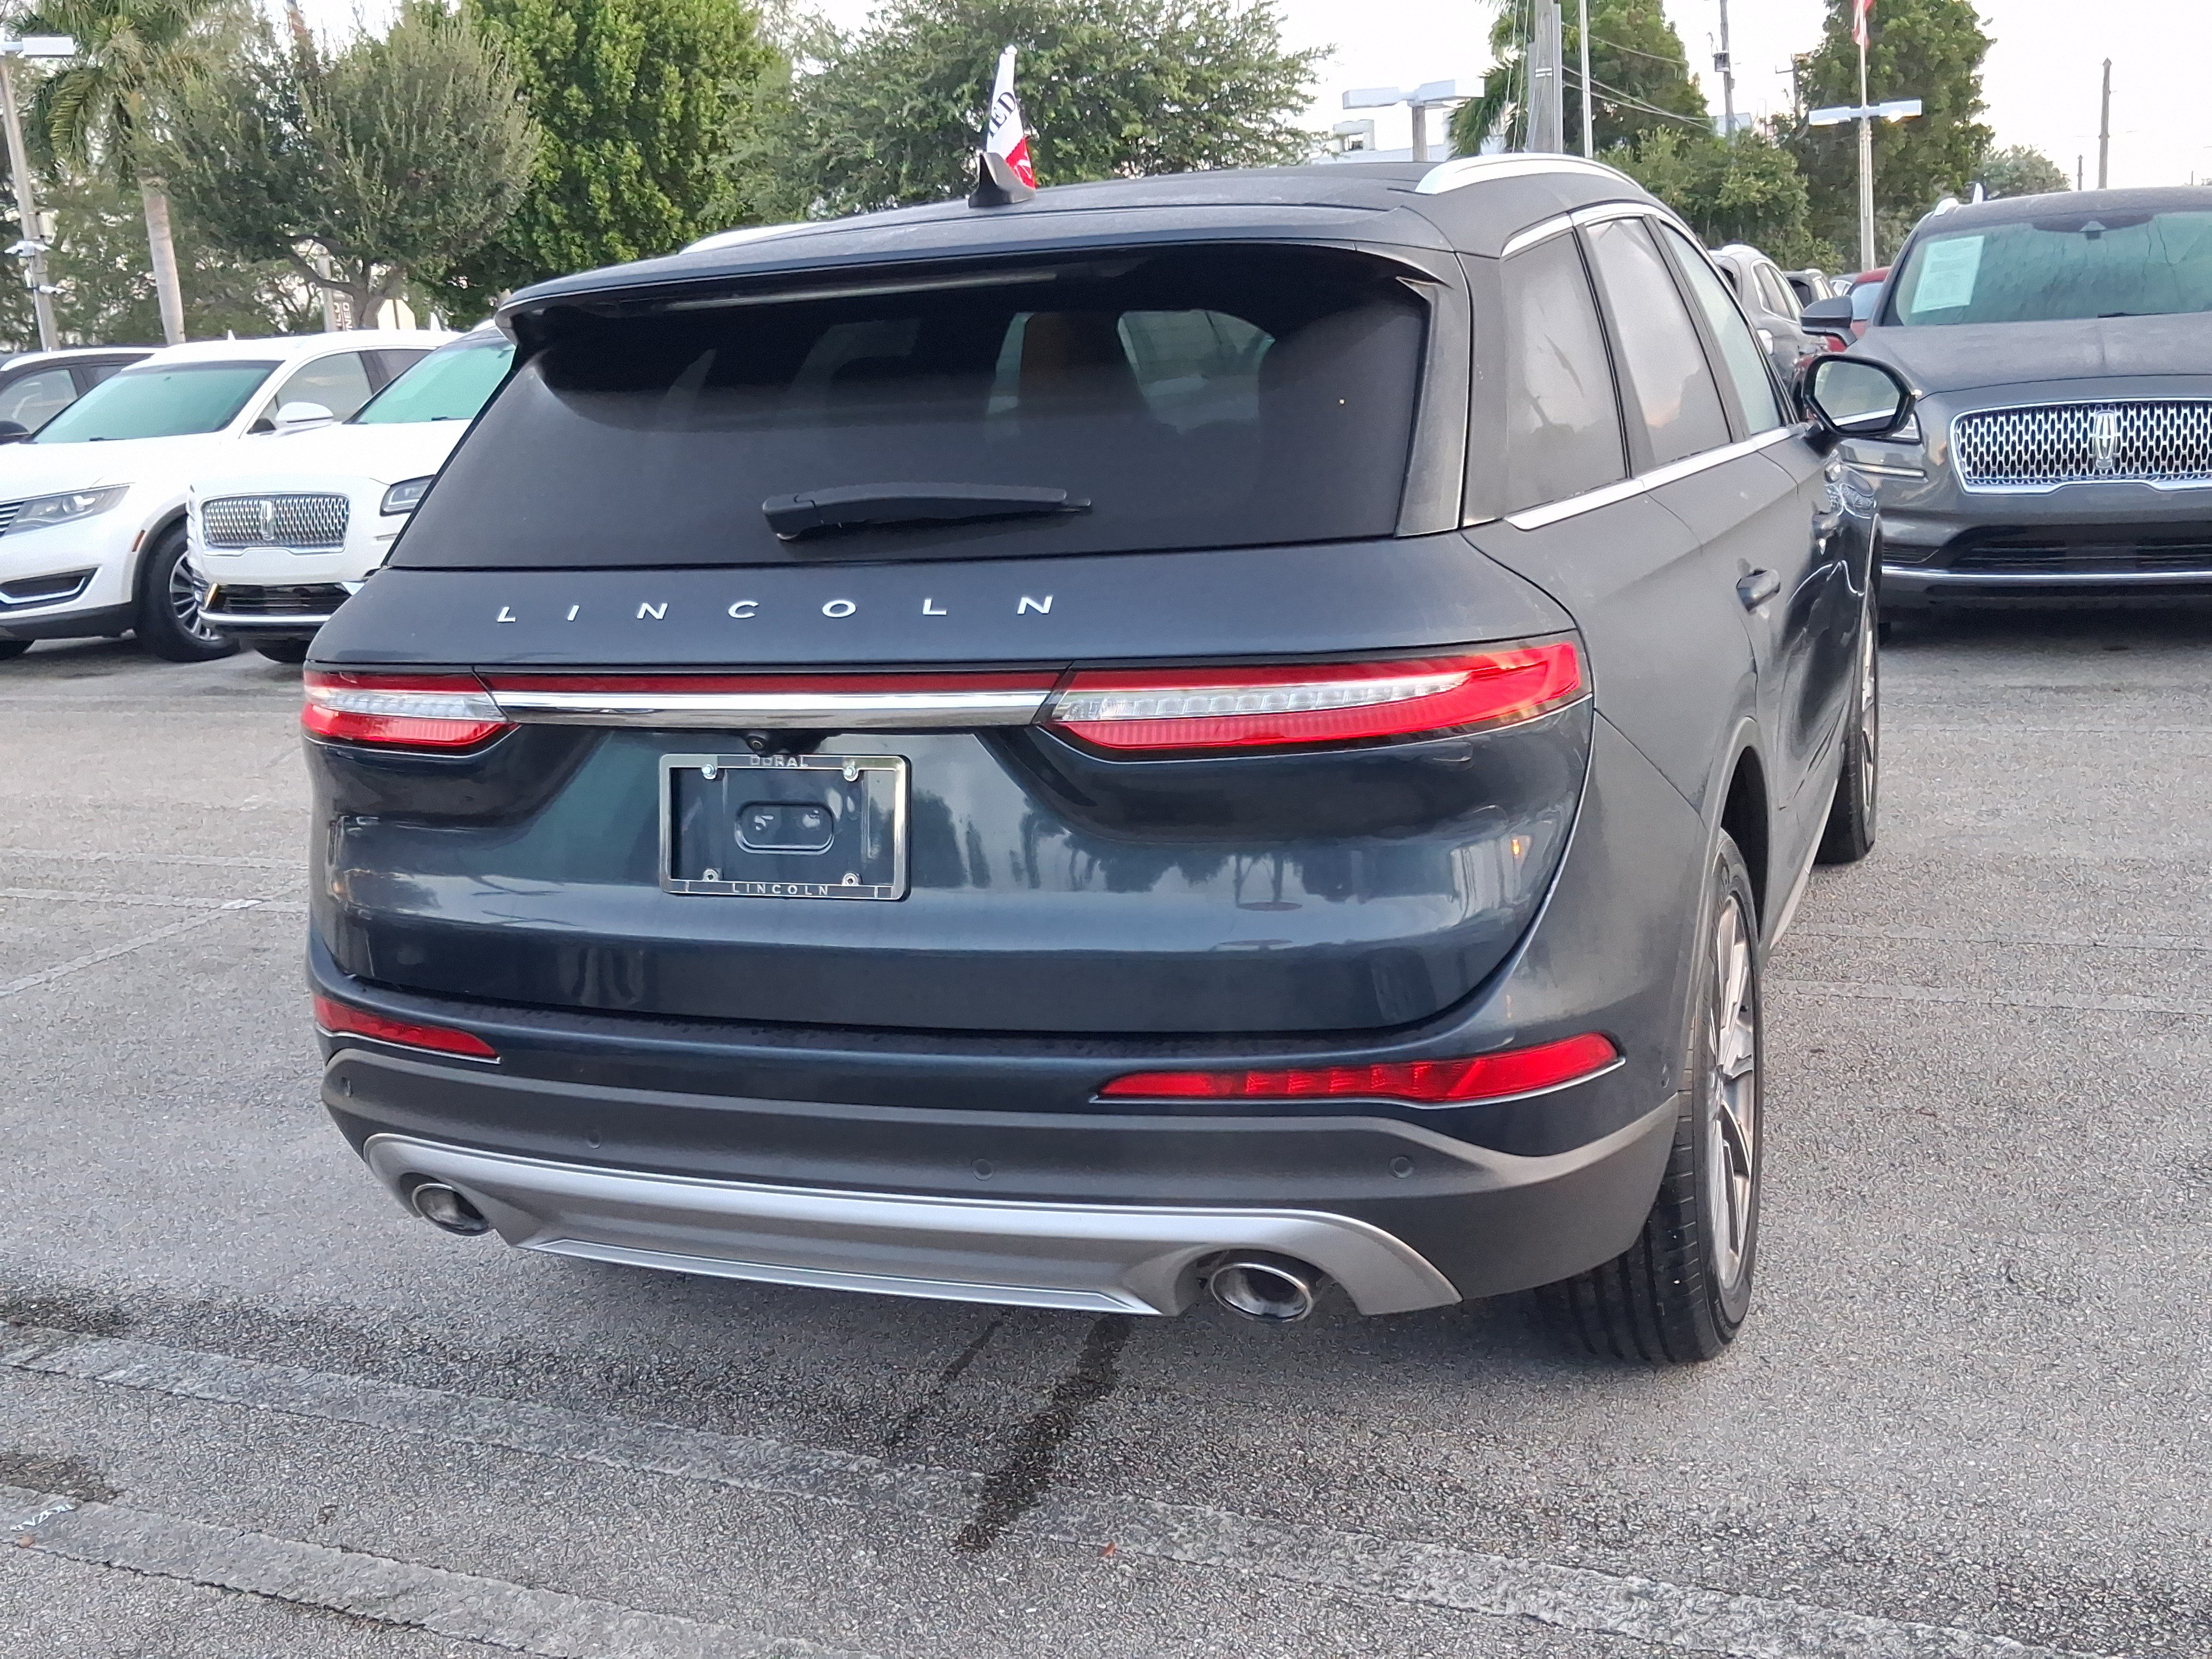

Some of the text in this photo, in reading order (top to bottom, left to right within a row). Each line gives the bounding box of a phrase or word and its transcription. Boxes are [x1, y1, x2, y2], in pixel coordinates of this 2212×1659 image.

[496, 595, 1054, 623] LINCOLN
[750, 754, 808, 768] DORAL
[731, 882, 829, 896] LINCOLN
